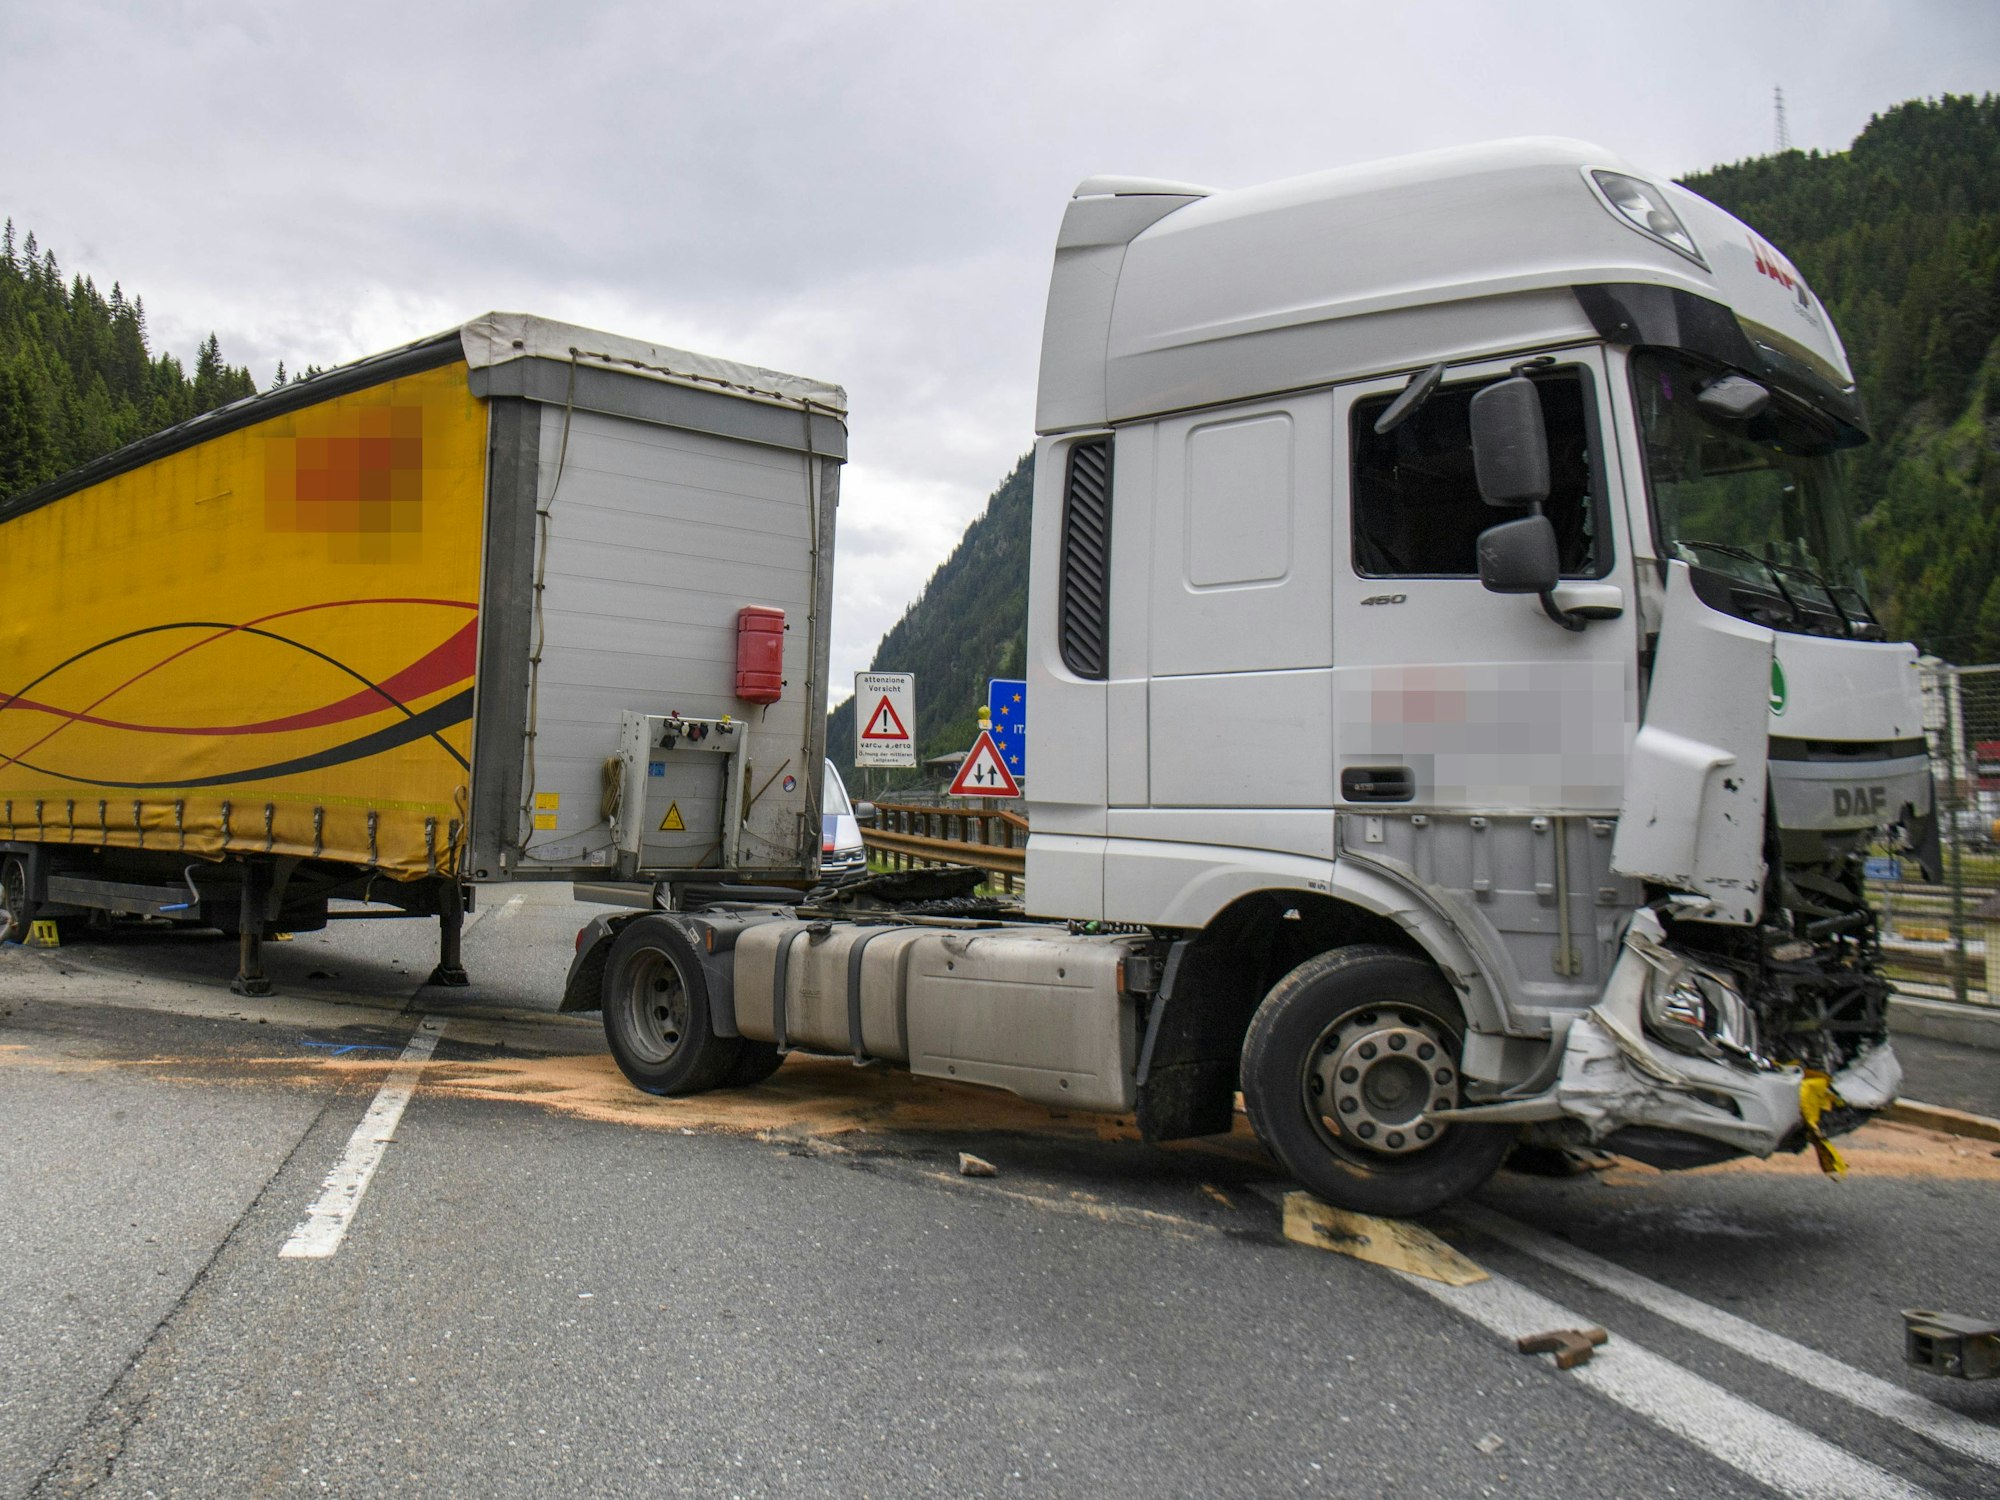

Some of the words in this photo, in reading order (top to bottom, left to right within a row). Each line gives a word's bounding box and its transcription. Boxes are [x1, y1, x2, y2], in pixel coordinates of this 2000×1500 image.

[1361, 594, 1407, 605] 460
[864, 676, 905, 684] attenzione
[1014, 725, 1026, 734] IT
[1833, 787, 1887, 816] DAF
